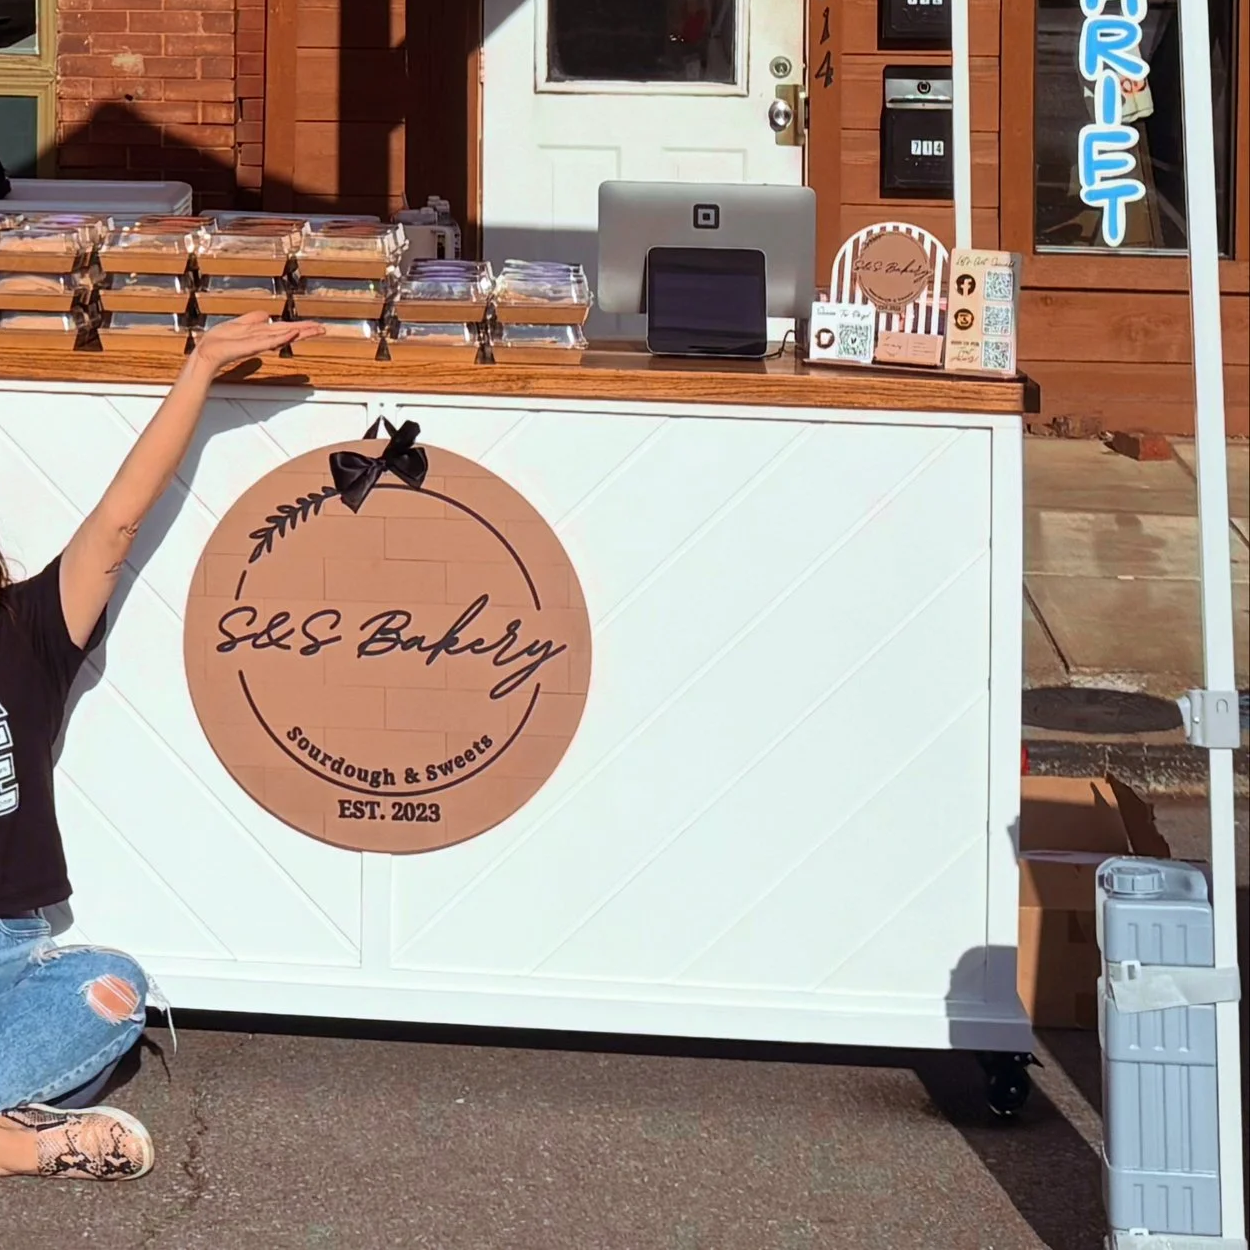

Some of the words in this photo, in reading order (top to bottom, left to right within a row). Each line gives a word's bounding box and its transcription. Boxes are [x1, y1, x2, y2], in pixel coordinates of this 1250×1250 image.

[911, 140, 944, 156] 714
[216, 605, 342, 656] S&S
[356, 593, 568, 700] Bakery
[286, 725, 397, 788] Sourdough
[403, 767, 421, 785] &
[425, 733, 494, 782] Sweets
[337, 799, 386, 820] EST.
[390, 801, 442, 822] 2023
